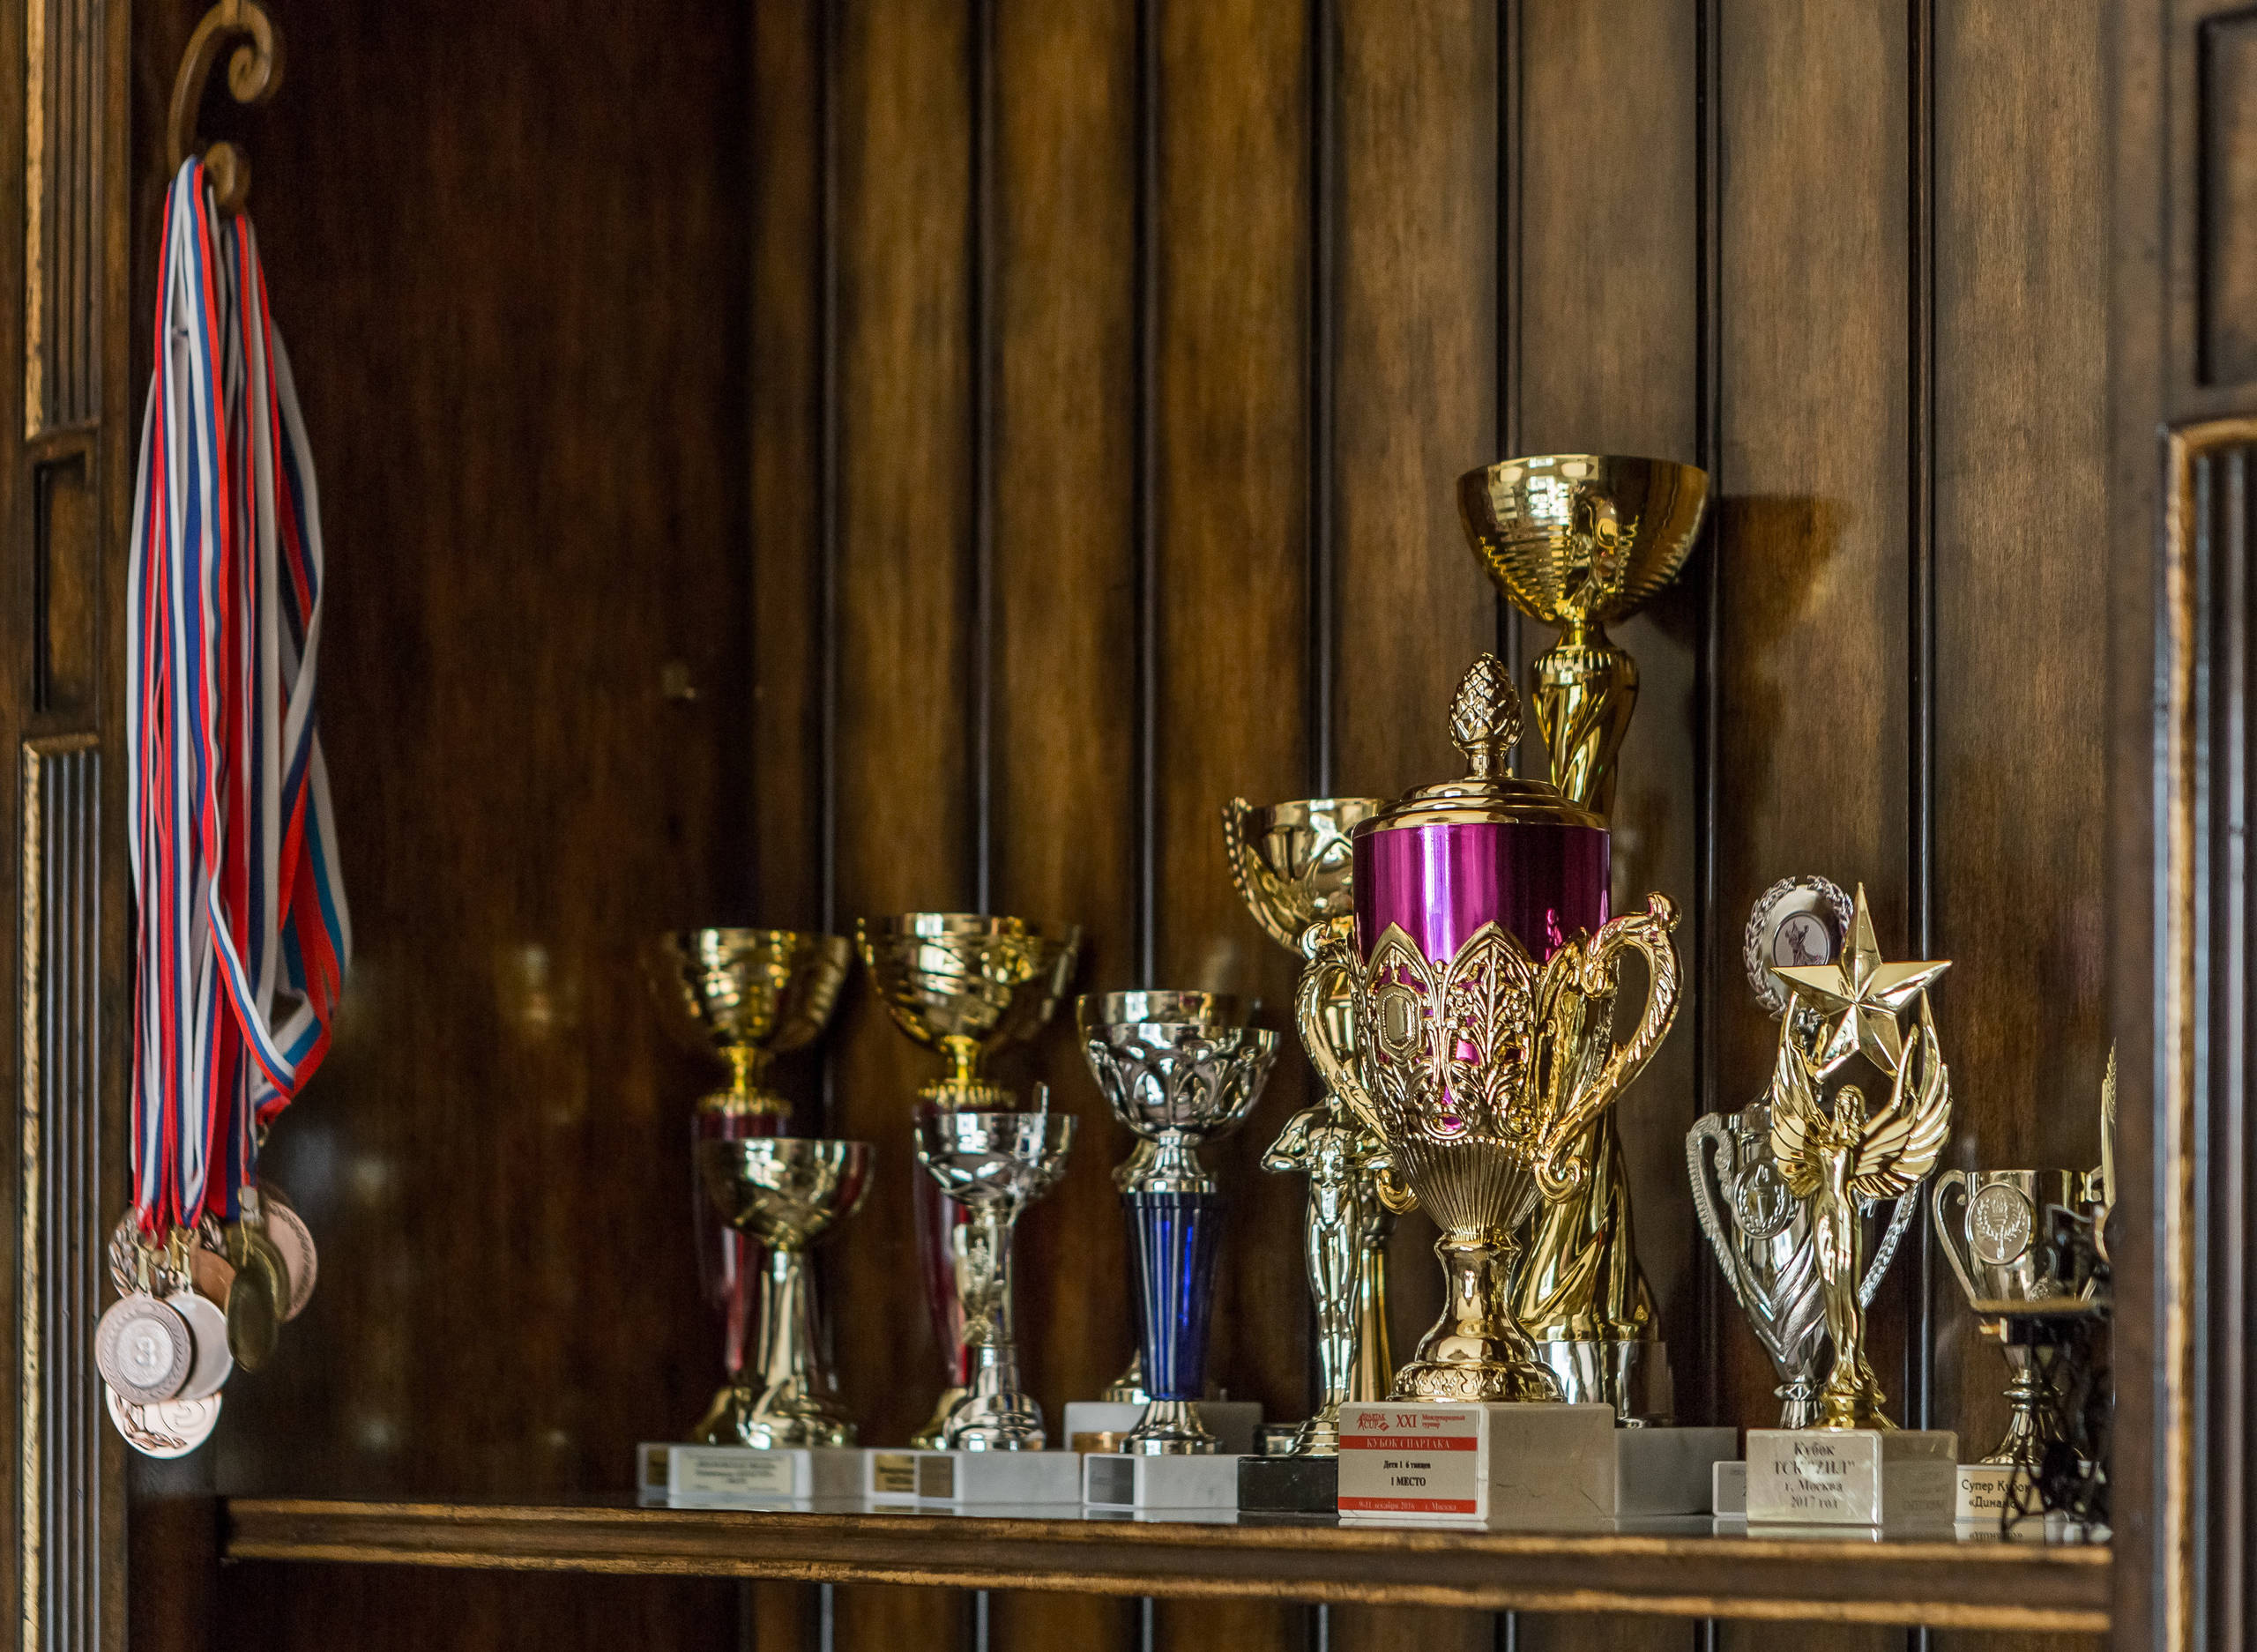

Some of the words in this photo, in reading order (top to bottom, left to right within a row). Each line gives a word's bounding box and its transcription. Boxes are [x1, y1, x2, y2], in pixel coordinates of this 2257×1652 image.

[1396, 1414, 1418, 1428] XXI
[1367, 1438, 1398, 1448] КУБОК
[1400, 1438, 1451, 1449] СПАРТАКА
[1793, 1440, 1836, 1457] Кубок
[1397, 1477, 1426, 1487] МЕСТО
[1799, 1478, 1844, 1492] Москва
[1962, 1478, 1994, 1494] Супер
